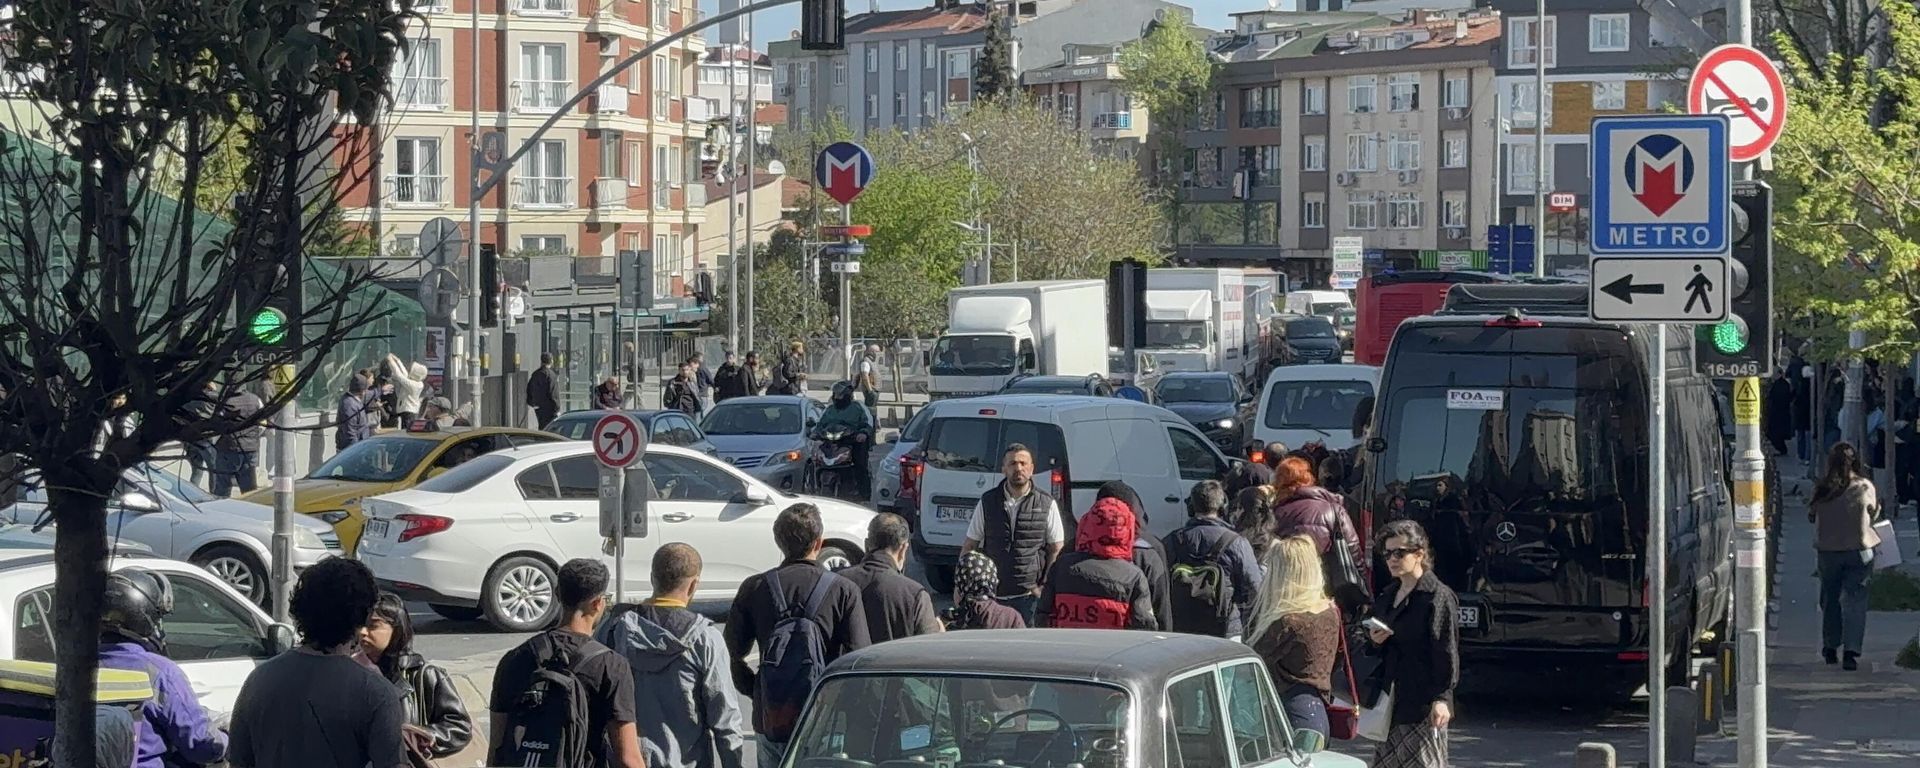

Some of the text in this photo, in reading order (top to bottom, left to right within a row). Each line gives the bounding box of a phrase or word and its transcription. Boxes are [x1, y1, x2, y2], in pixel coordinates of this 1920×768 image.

[1609, 226, 1710, 246] METRO
[1706, 363, 1758, 376] 16-049
[1450, 391, 1485, 401] FOA
[521, 741, 550, 750] adidas
